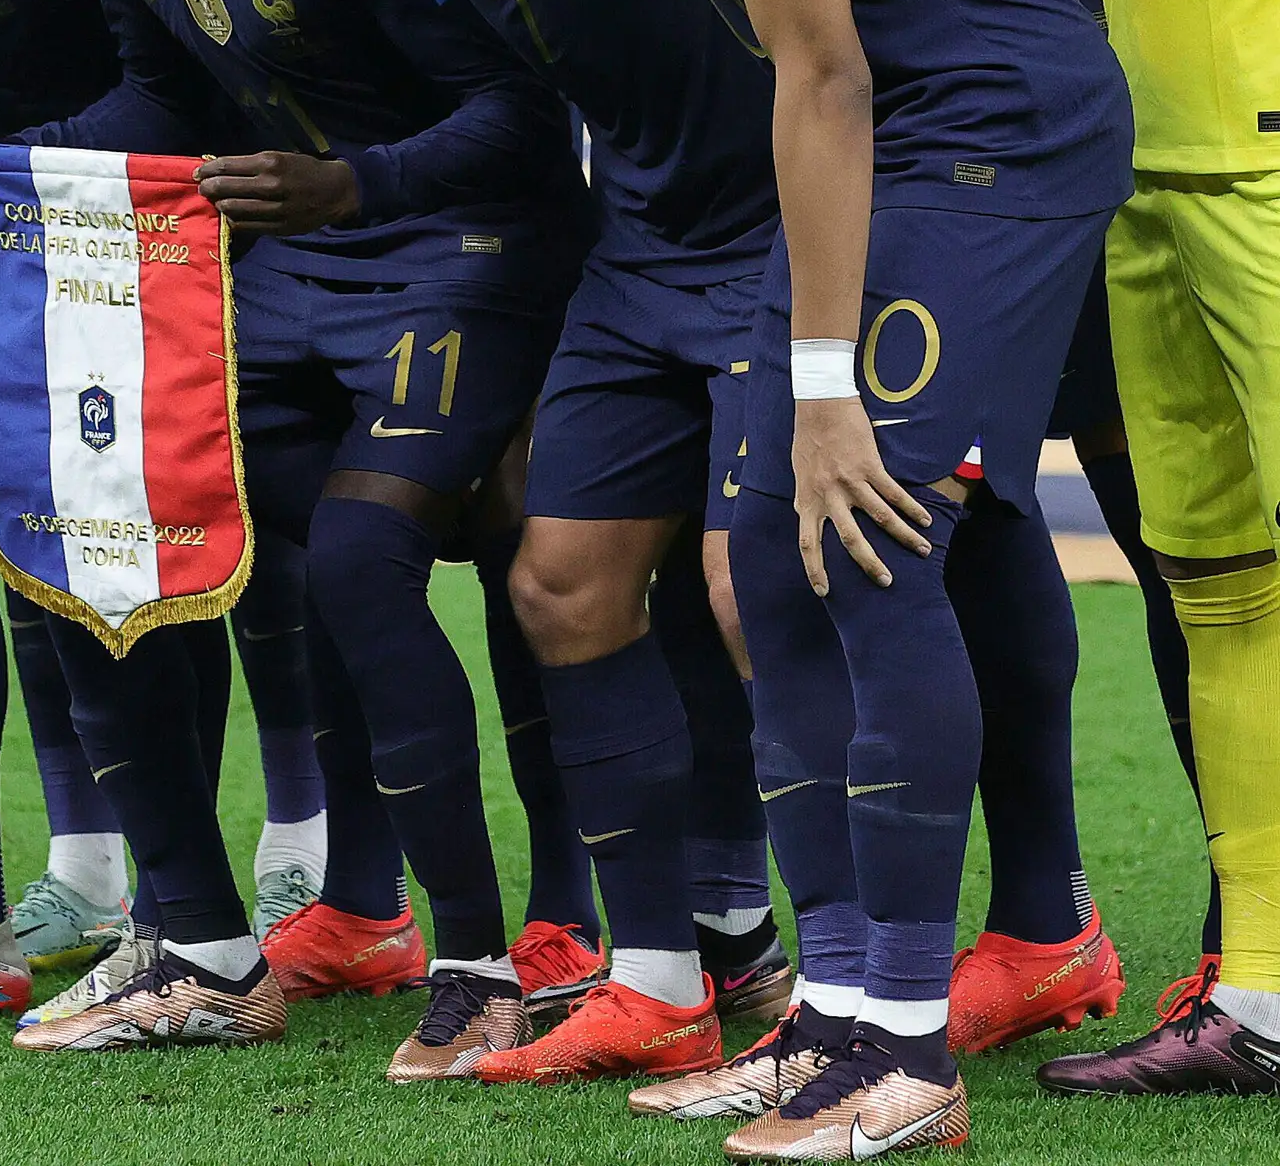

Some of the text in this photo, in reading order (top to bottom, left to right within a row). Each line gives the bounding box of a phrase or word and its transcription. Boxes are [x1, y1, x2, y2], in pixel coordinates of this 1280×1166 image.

[4, 203, 181, 233] COUPE DU MONDE
[22, 233, 43, 254] LA
[47, 236, 80, 256] FIFA
[85, 239, 145, 262] QATAR
[148, 241, 191, 265] 2022
[55, 277, 136, 307] FINALE
[384, 329, 462, 417] 11
[85, 430, 111, 440] FRANCE
[41, 515, 148, 542] DECEMBRE
[151, 524, 206, 547] 2022
[82, 546, 141, 569] DOHA
[1023, 954, 1083, 1001] ULTRA
[640, 1024, 699, 1050] ULTRA
